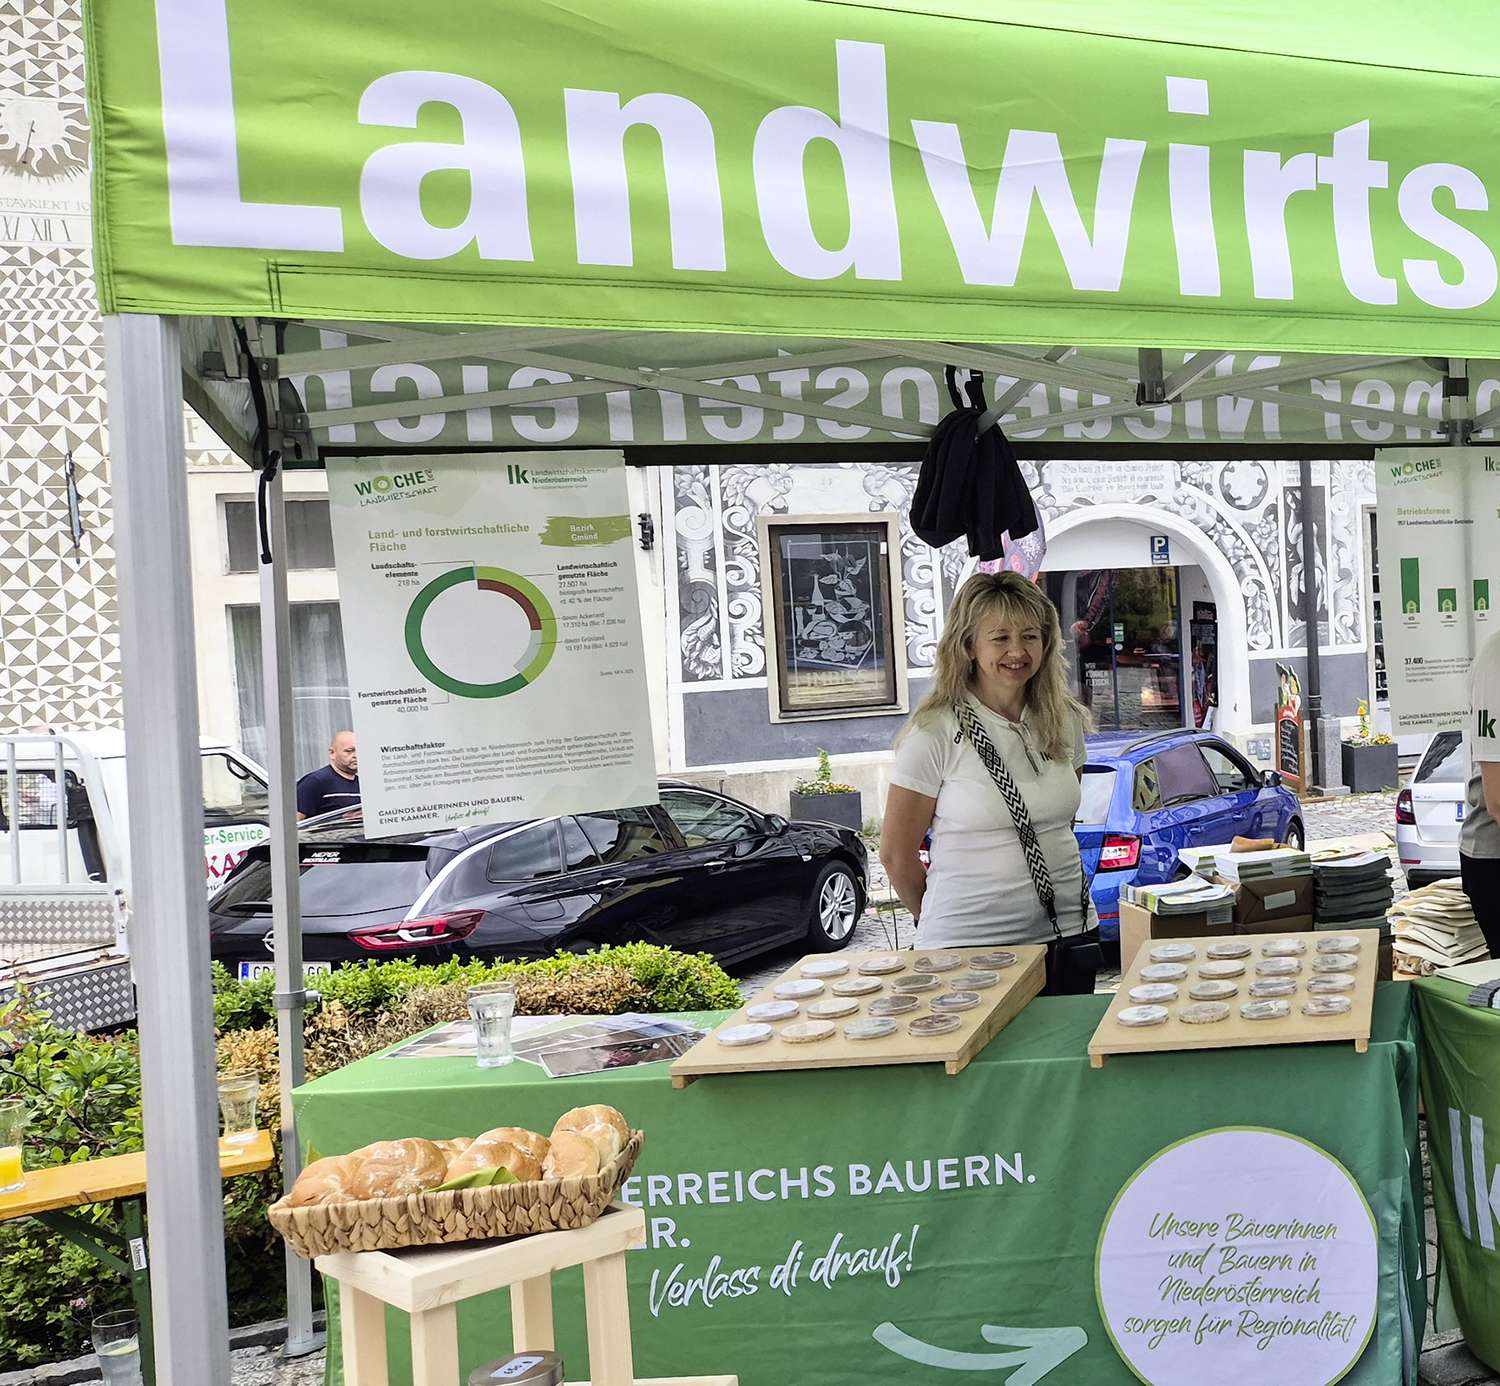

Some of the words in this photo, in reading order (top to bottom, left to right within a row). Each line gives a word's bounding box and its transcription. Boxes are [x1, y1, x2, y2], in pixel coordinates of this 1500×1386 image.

[507, 464, 529, 485] lk
[1391, 459, 1436, 478] WOCHE
[1485, 456, 1495, 472] lk
[354, 470, 426, 496] WOCHE
[368, 529, 399, 540] Land-
[402, 527, 422, 537] und
[425, 523, 530, 537] forstwirtschaftliche
[369, 542, 407, 553] Fläche
[1478, 709, 1497, 739] lk
[380, 741, 446, 753] Wirtschaftsfaktor
[378, 807, 415, 817] GMÜNDS
[416, 801, 470, 812] BÄUERINNEN
[471, 798, 490, 807] UND
[490, 795, 526, 804] BAUERN.
[379, 817, 399, 825] EINE
[401, 812, 440, 822] KAMMER.
[848, 1152, 1036, 1196] BAUERN.
[1148, 1211, 1220, 1241] Unsere
[1225, 1213, 1338, 1242] Bäuerinnen
[648, 1255, 760, 1318] Verlass
[769, 1240, 804, 1297] di
[809, 1224, 920, 1290] drauf!
[1167, 1243, 1216, 1275] und
[1218, 1246, 1294, 1275] Bauern
[1299, 1251, 1318, 1272] in
[1158, 1274, 1322, 1308] Niederösterreich
[1123, 1313, 1192, 1351] sorgen
[1193, 1312, 1233, 1346] für
[1236, 1309, 1358, 1351] Regionalität!
